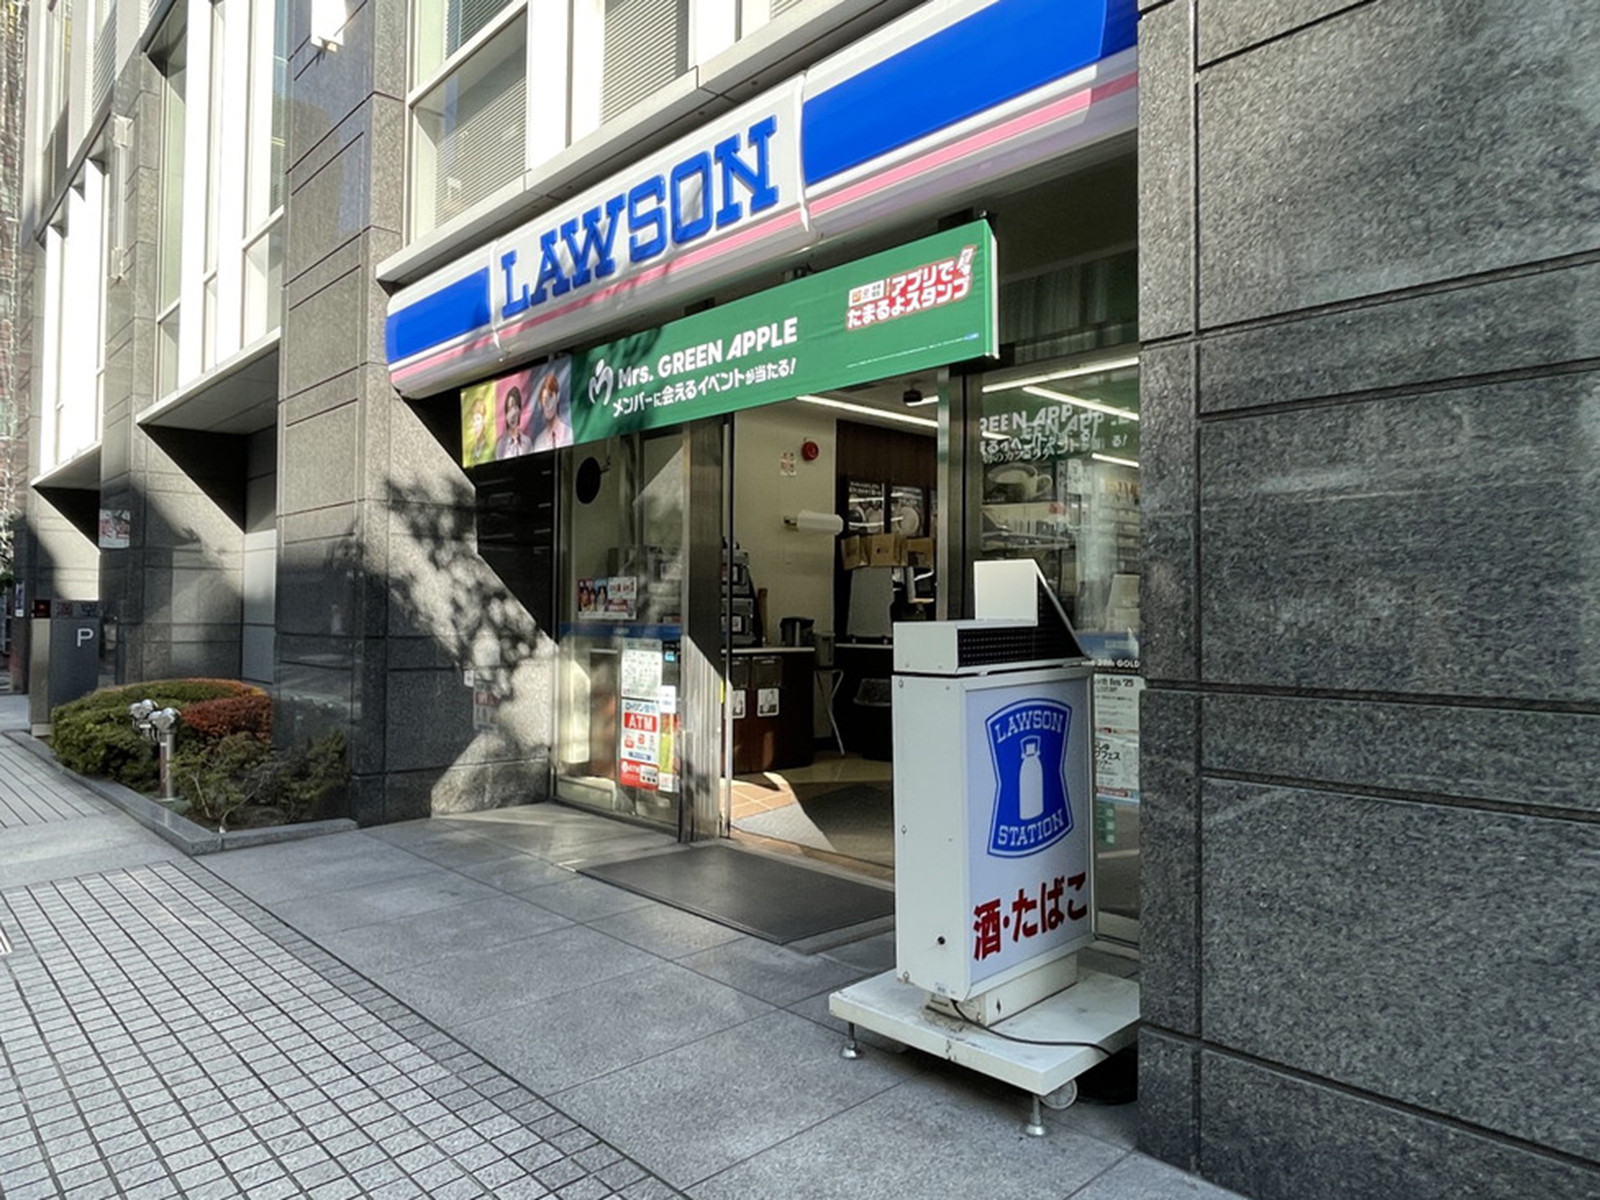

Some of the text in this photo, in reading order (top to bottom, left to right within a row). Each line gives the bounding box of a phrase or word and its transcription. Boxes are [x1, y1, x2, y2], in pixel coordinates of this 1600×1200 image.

[501, 115, 779, 320] LAWSON
[891, 260, 954, 298] アプリで
[618, 316, 798, 389] Mrs. GREEN APPLE
[77, 628, 94, 647] P
[629, 713, 653, 731] ATM
[994, 710, 1063, 744] LAWSON
[997, 809, 1065, 846] STATION
[973, 872, 1087, 960] 酒・たばこ
